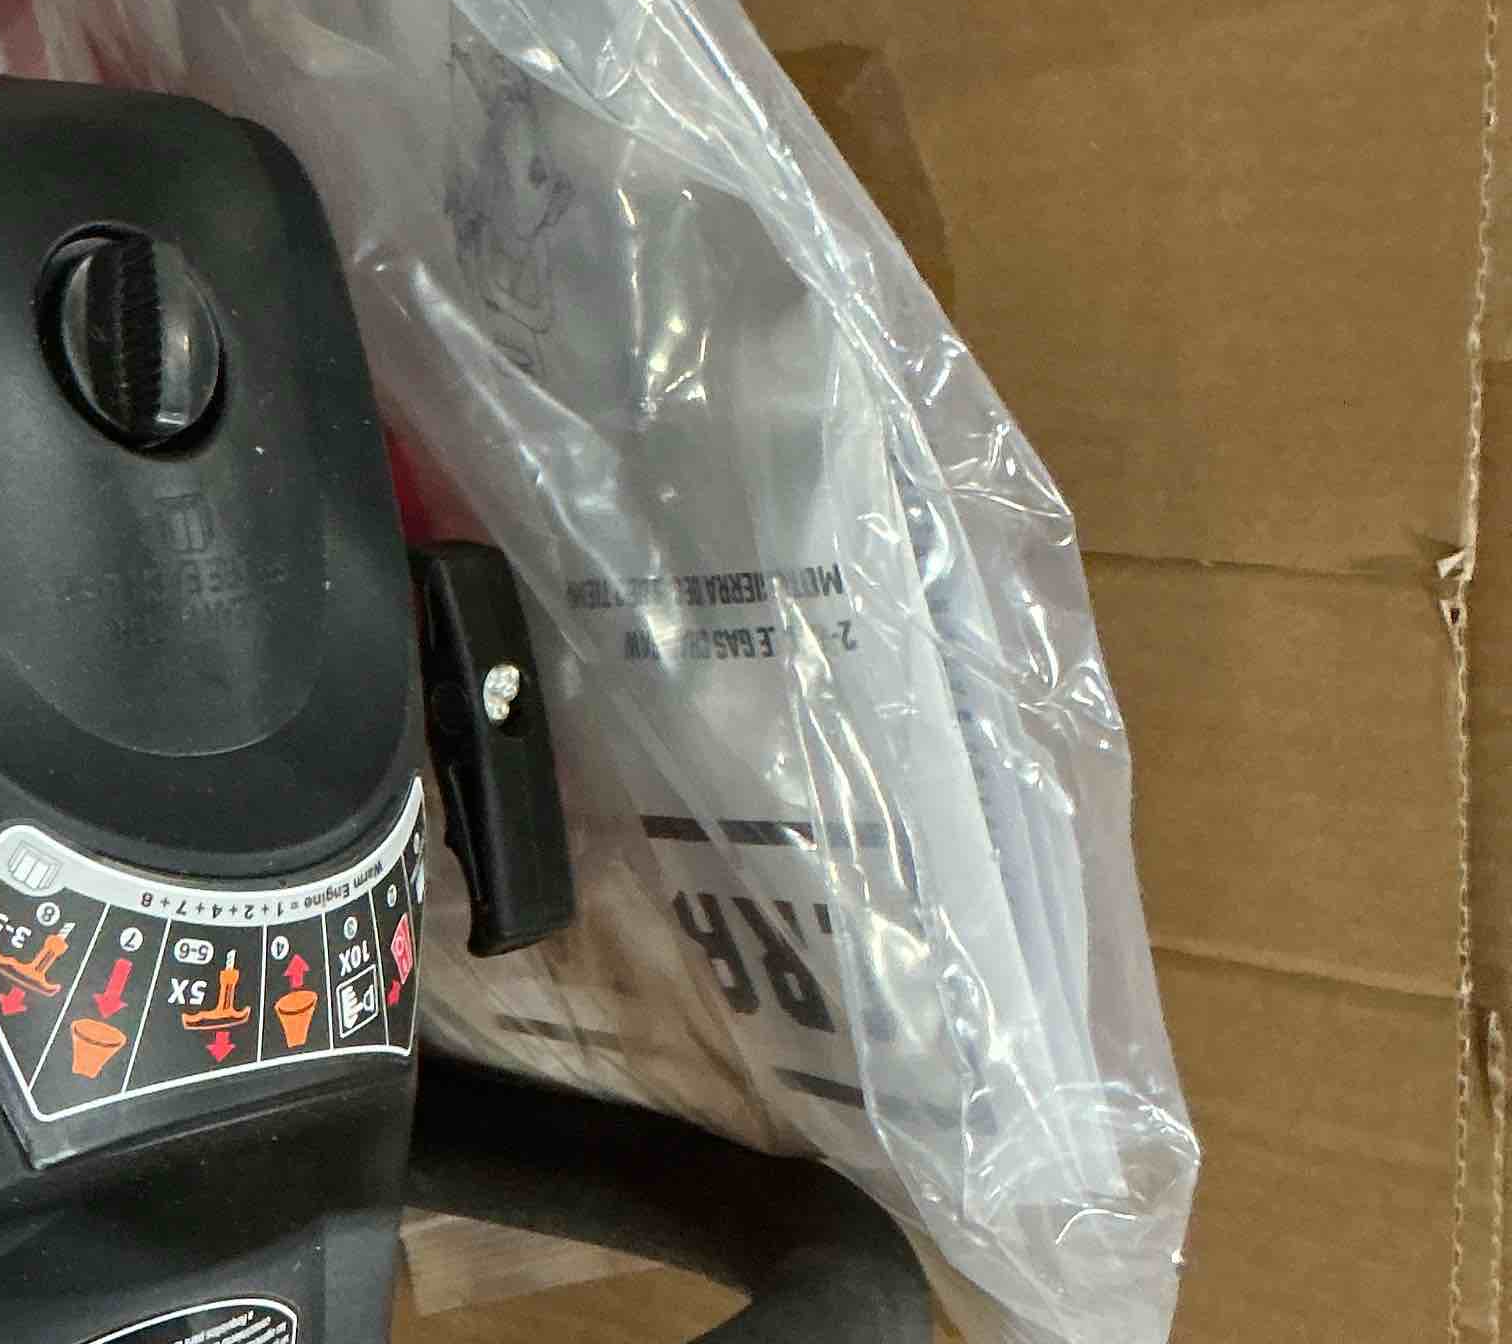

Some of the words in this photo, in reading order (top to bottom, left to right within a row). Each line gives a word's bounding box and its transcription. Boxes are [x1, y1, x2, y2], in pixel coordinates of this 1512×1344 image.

[712, 628, 751, 660] GAS
[352, 860, 384, 894] Warm
[140, 892, 154, 910] 8
[303, 885, 351, 911] Engine
[175, 900, 187, 917] 7
[212, 903, 224, 920] 4
[243, 904, 255, 921] 2
[275, 900, 285, 917] 1
[177, 941, 209, 961] 5-6
[338, 937, 372, 972] 10X
[166, 974, 208, 1006] 5X
